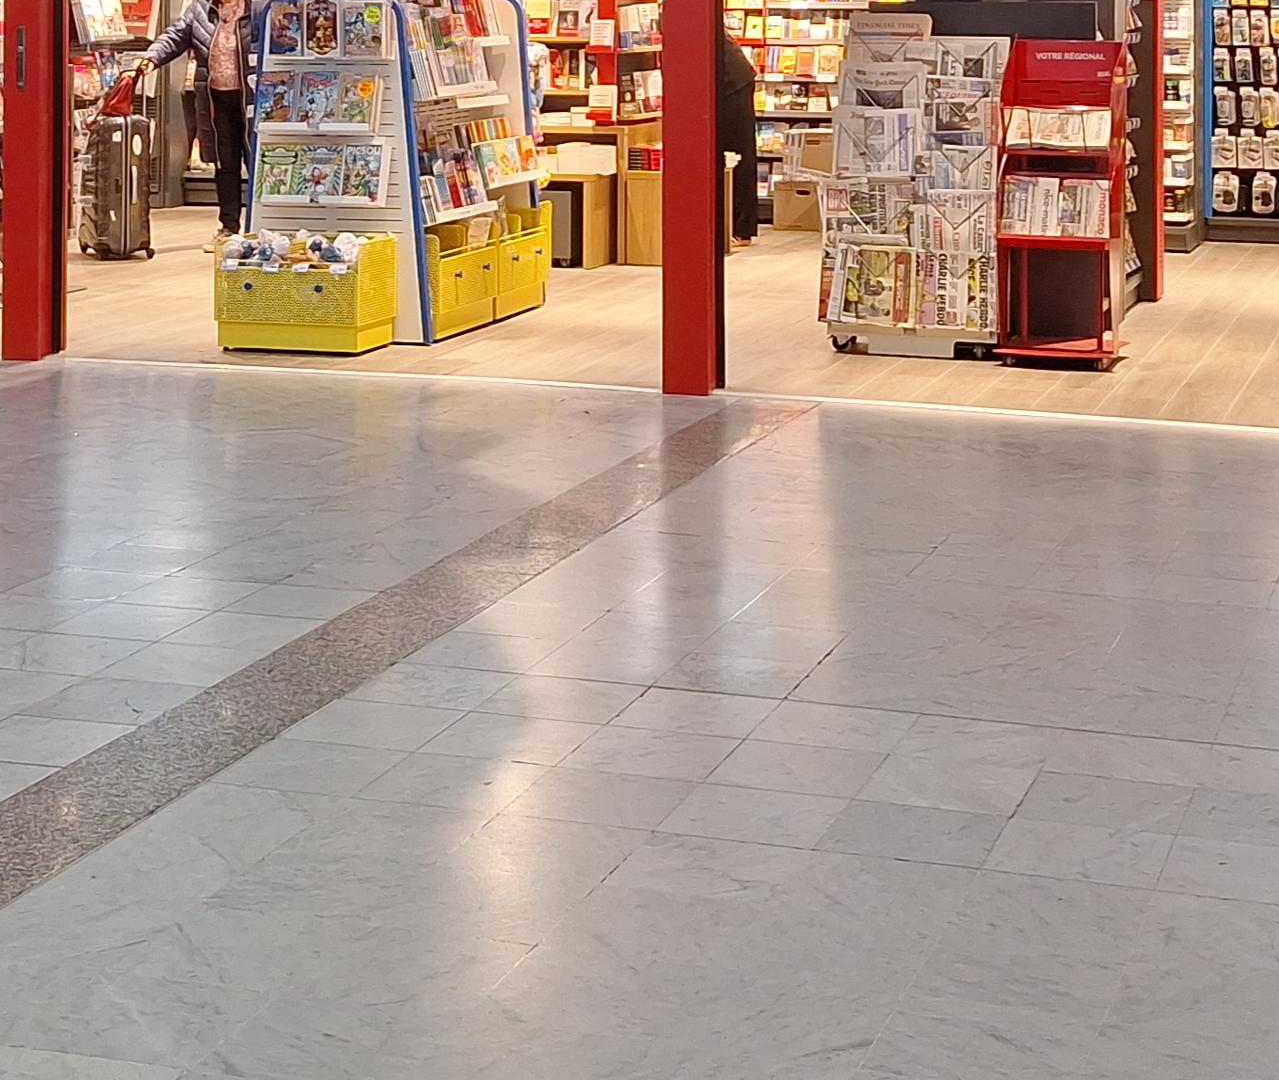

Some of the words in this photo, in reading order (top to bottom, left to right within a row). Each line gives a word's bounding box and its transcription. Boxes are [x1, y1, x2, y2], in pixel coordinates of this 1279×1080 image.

[1035, 52, 1063, 60] VOTRE
[1064, 51, 1106, 61] RÉGIONAL
[347, 145, 381, 156] PICSOU
[1096, 192, 1108, 235] monaco
[937, 253, 948, 290] CHARLIE
[936, 292, 947, 326] HEBDO
